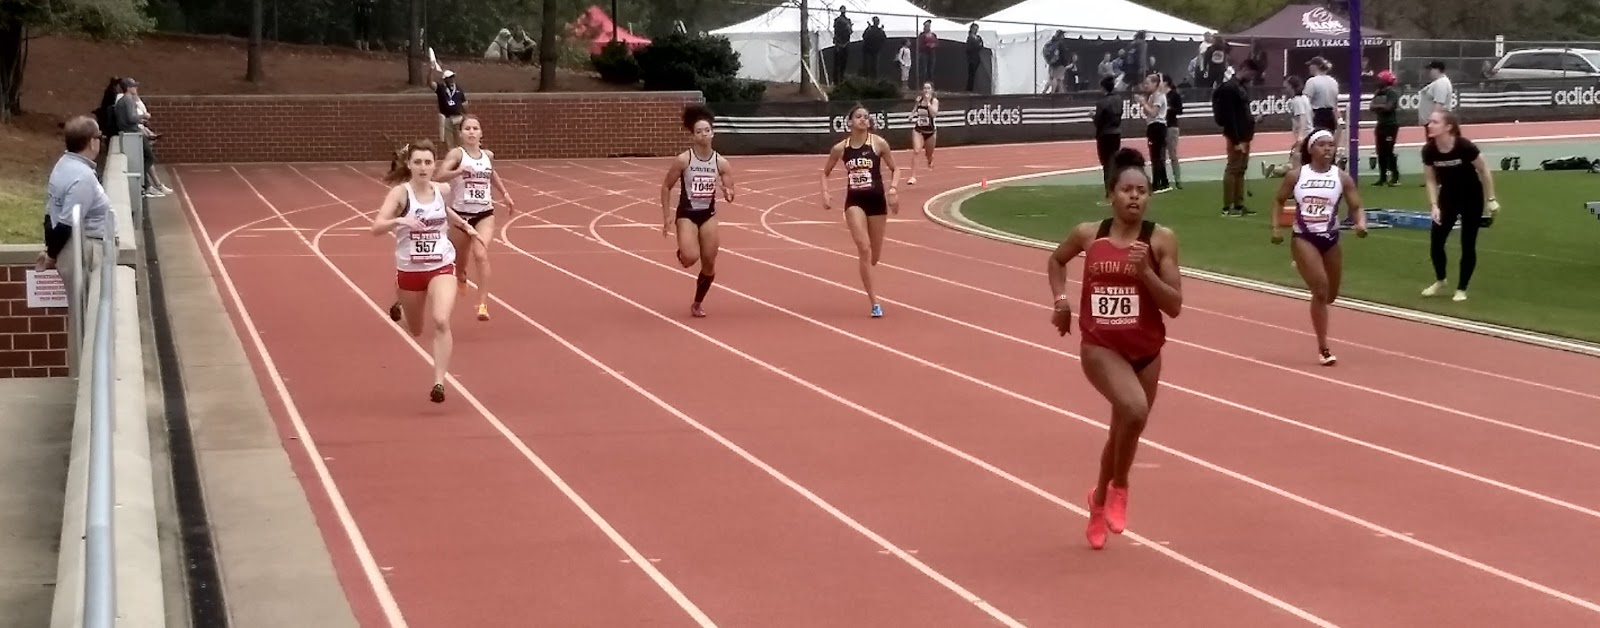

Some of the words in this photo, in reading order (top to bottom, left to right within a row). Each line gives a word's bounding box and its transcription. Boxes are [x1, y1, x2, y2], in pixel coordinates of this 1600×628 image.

[1296, 39, 1320, 48] ELON
[1321, 39, 1350, 47] TRACK
[967, 104, 1020, 125] adidas
[1306, 204, 1326, 216] 472
[415, 240, 437, 253] 557
[1098, 297, 1132, 315] 876
